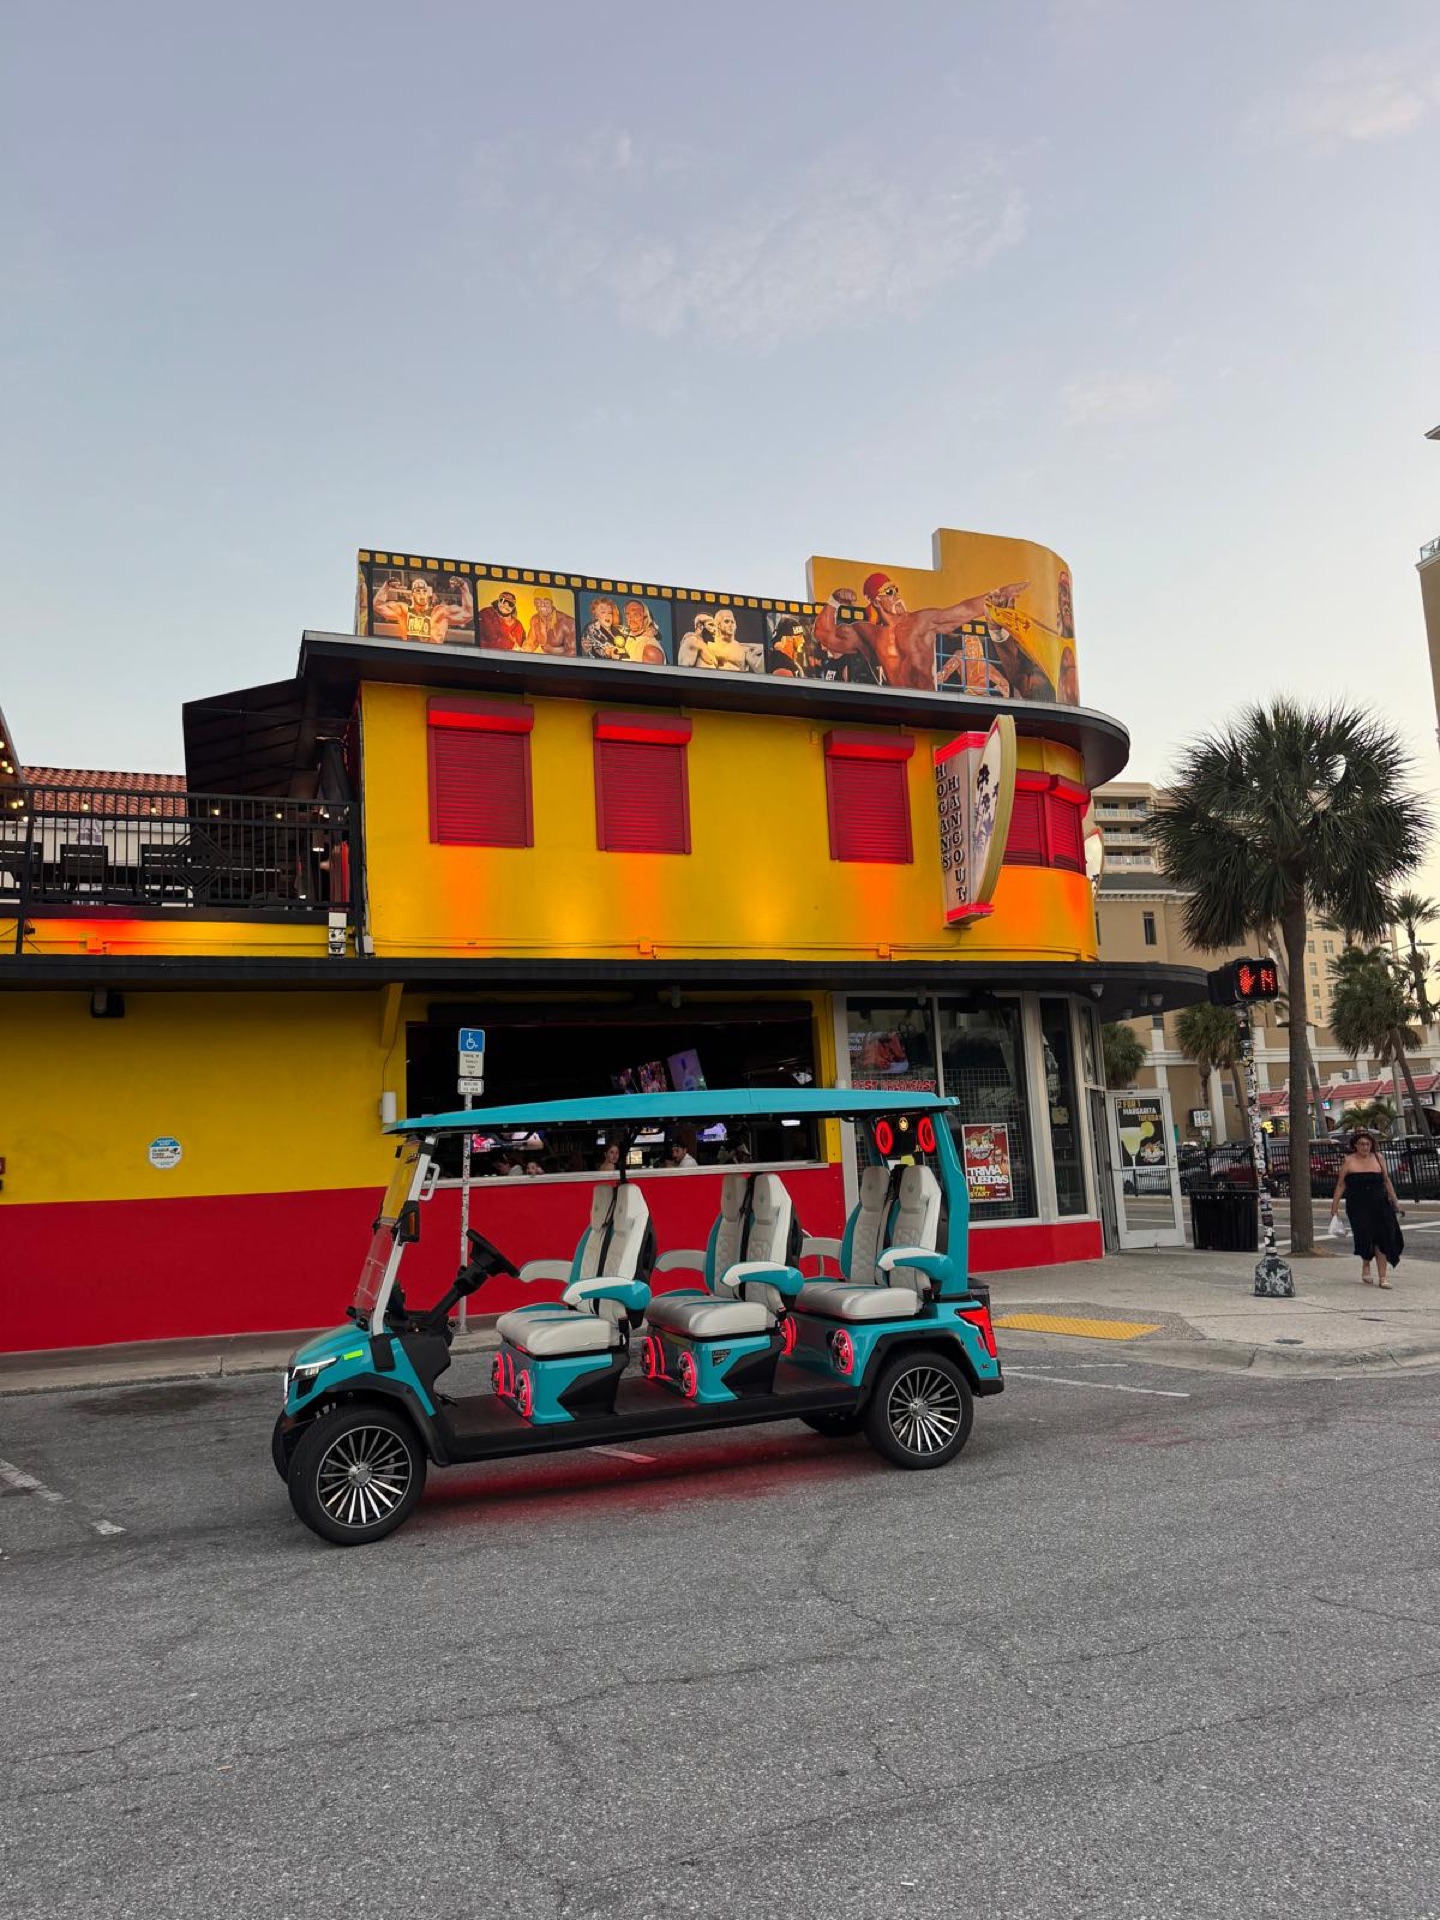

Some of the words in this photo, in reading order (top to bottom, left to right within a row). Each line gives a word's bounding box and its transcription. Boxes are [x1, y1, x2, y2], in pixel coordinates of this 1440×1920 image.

[947, 775, 966, 902] HANGOUT
[852, 1079, 878, 1091] BEST
[1122, 1099, 1136, 1109] FOR
[1122, 1107, 1157, 1115] MARGARITA
[967, 1165, 1002, 1176] TRIVIA
[966, 1175, 1009, 1185] TUESDAYS
